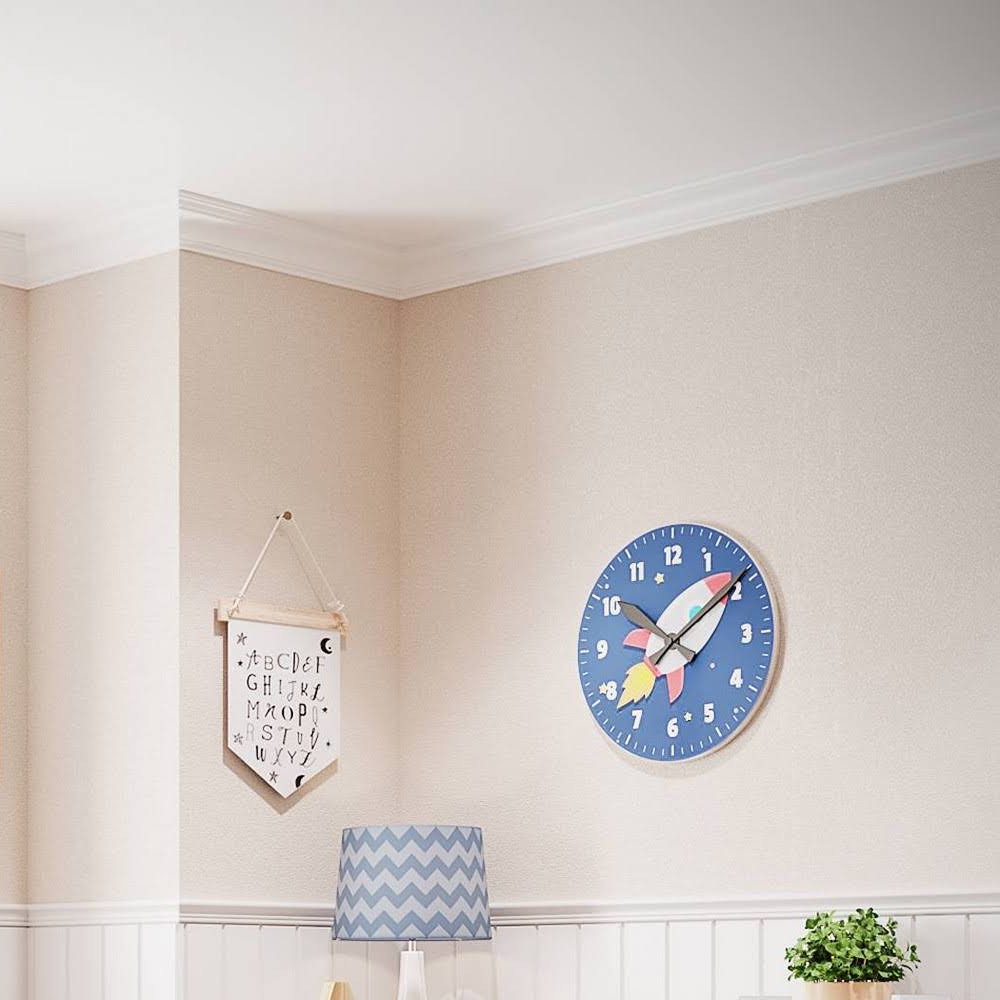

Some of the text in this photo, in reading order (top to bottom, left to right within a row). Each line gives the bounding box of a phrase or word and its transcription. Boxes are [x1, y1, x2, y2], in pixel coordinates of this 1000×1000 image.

[663, 545, 682, 565] 12
[703, 552, 712, 572] 1
[630, 562, 645, 581] 11
[730, 580, 742, 600] 2
[602, 596, 621, 616] 10
[740, 623, 752, 643] 3
[597, 640, 608, 659] 9
[729, 669, 743, 688] 4
[606, 681, 617, 700] 8
[632, 709, 643, 729] 7
[704, 703, 715, 723] 5
[667, 717, 678, 737] 6
